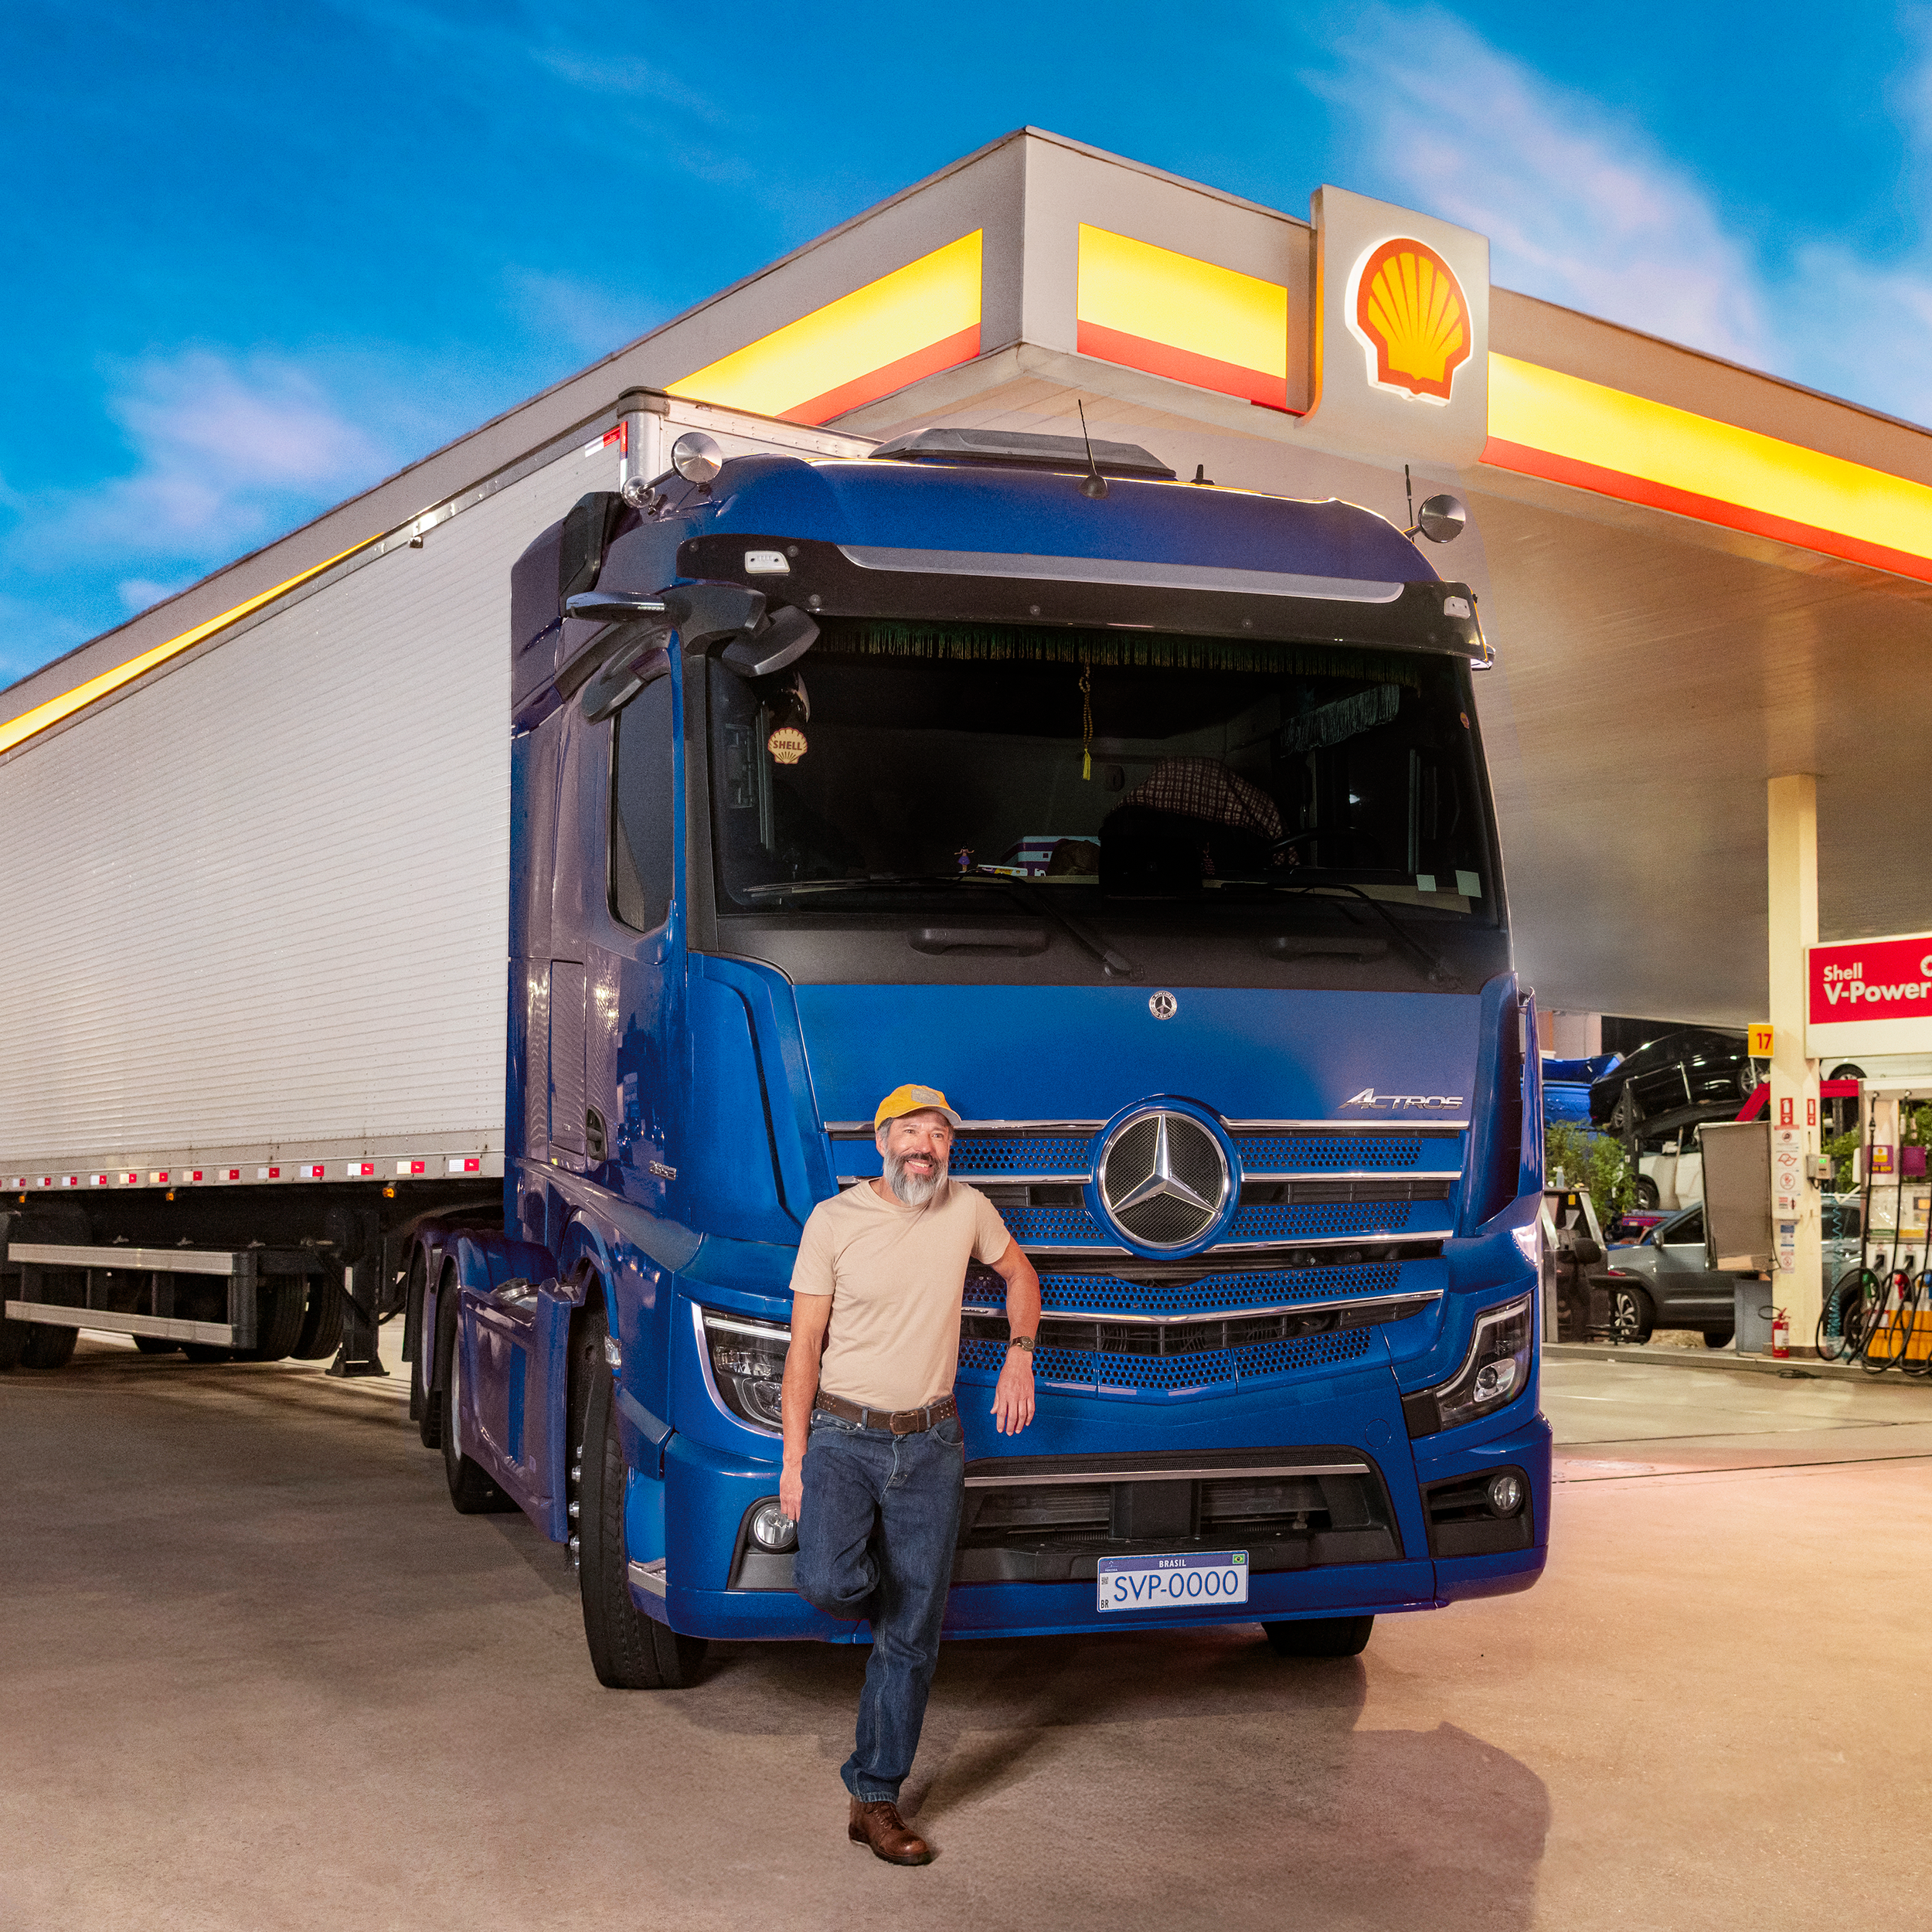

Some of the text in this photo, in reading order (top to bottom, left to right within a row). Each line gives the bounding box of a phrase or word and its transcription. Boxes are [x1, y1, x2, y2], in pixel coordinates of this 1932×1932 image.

[773, 740, 802, 750] SHELL
[1823, 961, 1862, 982] Shell
[1823, 980, 1932, 1005] V-Power
[1756, 1032, 1772, 1049] 17
[1337, 1087, 1464, 1110] ACTROS
[1158, 1559, 1187, 1568] BRASIL
[1114, 1570, 1239, 1602] SVP-0000
[1100, 1599, 1109, 1609] BR
